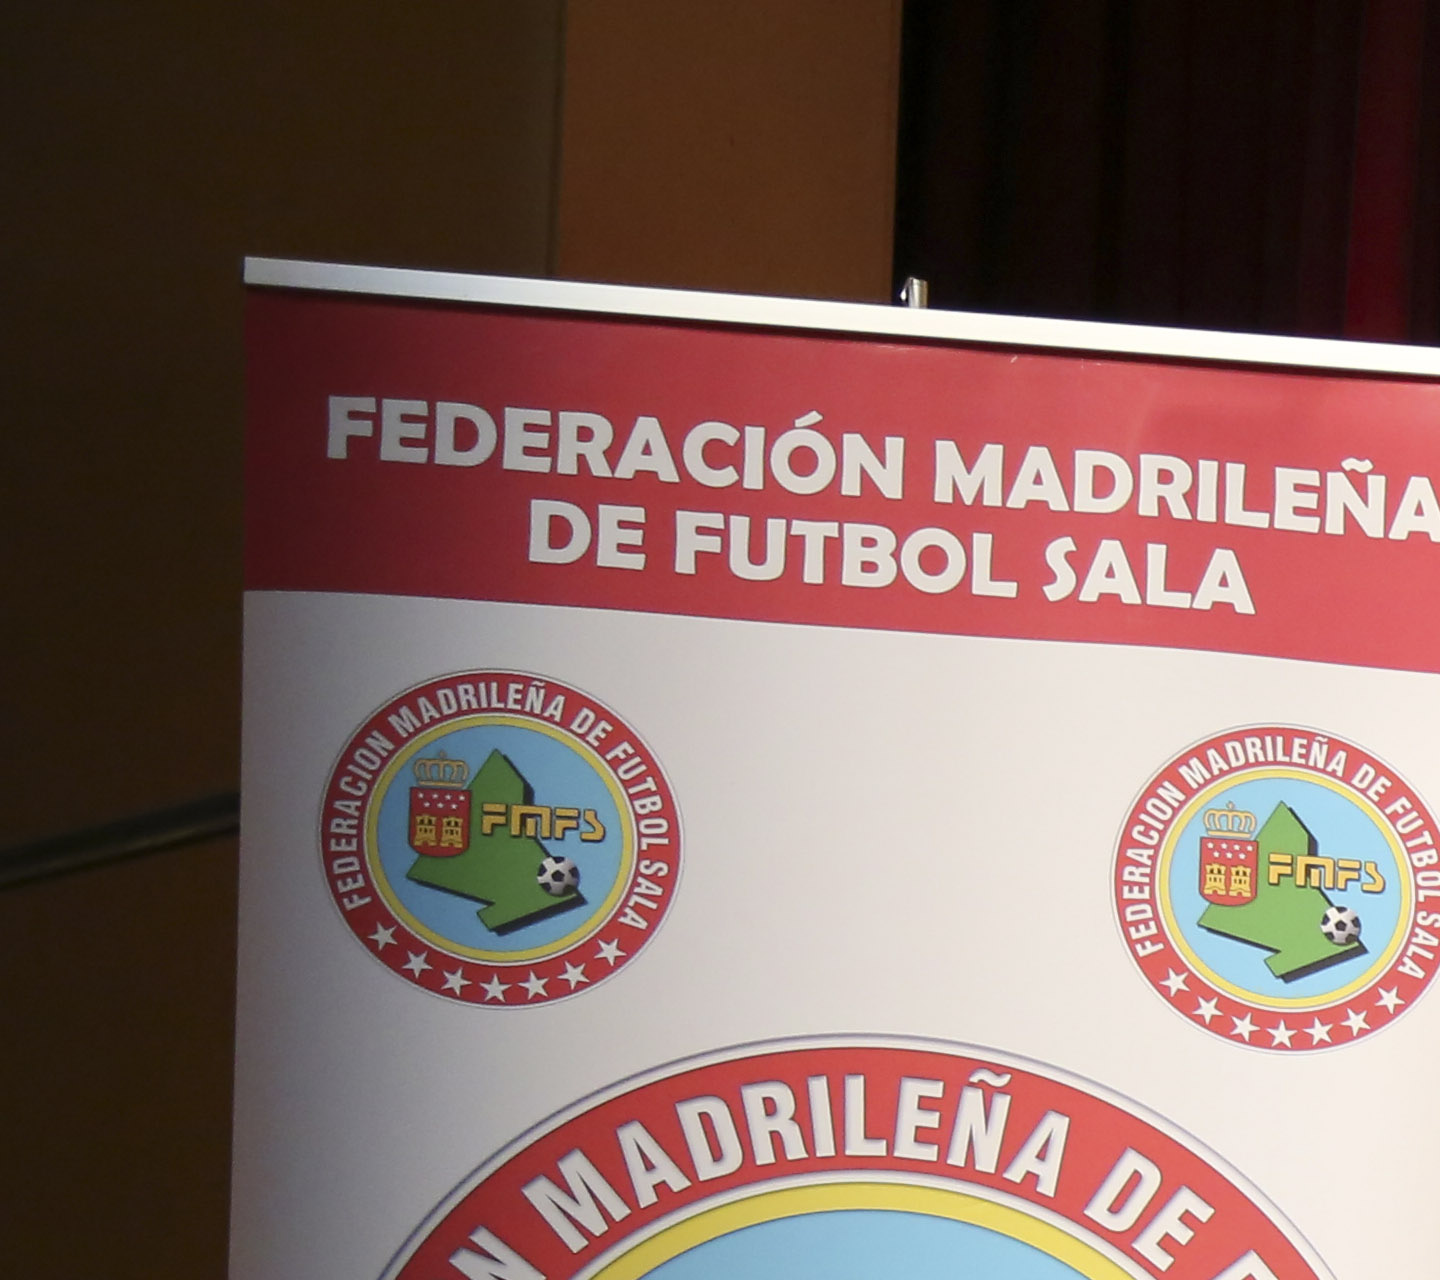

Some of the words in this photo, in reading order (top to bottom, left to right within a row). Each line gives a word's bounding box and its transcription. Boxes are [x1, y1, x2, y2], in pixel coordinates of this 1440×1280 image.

[327, 395, 905, 499] FEDERACIÓN
[528, 499, 646, 572] DE
[675, 516, 1016, 600] FUTBOL
[1042, 538, 1254, 614] SALA
[388, 681, 564, 738] MADRILEÑA
[570, 707, 613, 747] DE
[330, 731, 395, 911] FEDERACION
[481, 803, 606, 843] FMFS
[605, 741, 669, 850] FUTBOL
[1122, 780, 1186, 957] FEDERACION
[1178, 736, 1348, 788] MADRILEÑA
[1350, 762, 1392, 802] DE
[618, 859, 669, 931] SALA
[1267, 852, 1386, 893] FMFS
[520, 1070, 1072, 1255] MADRILEÑA
[1083, 1148, 1213, 1271] DE
